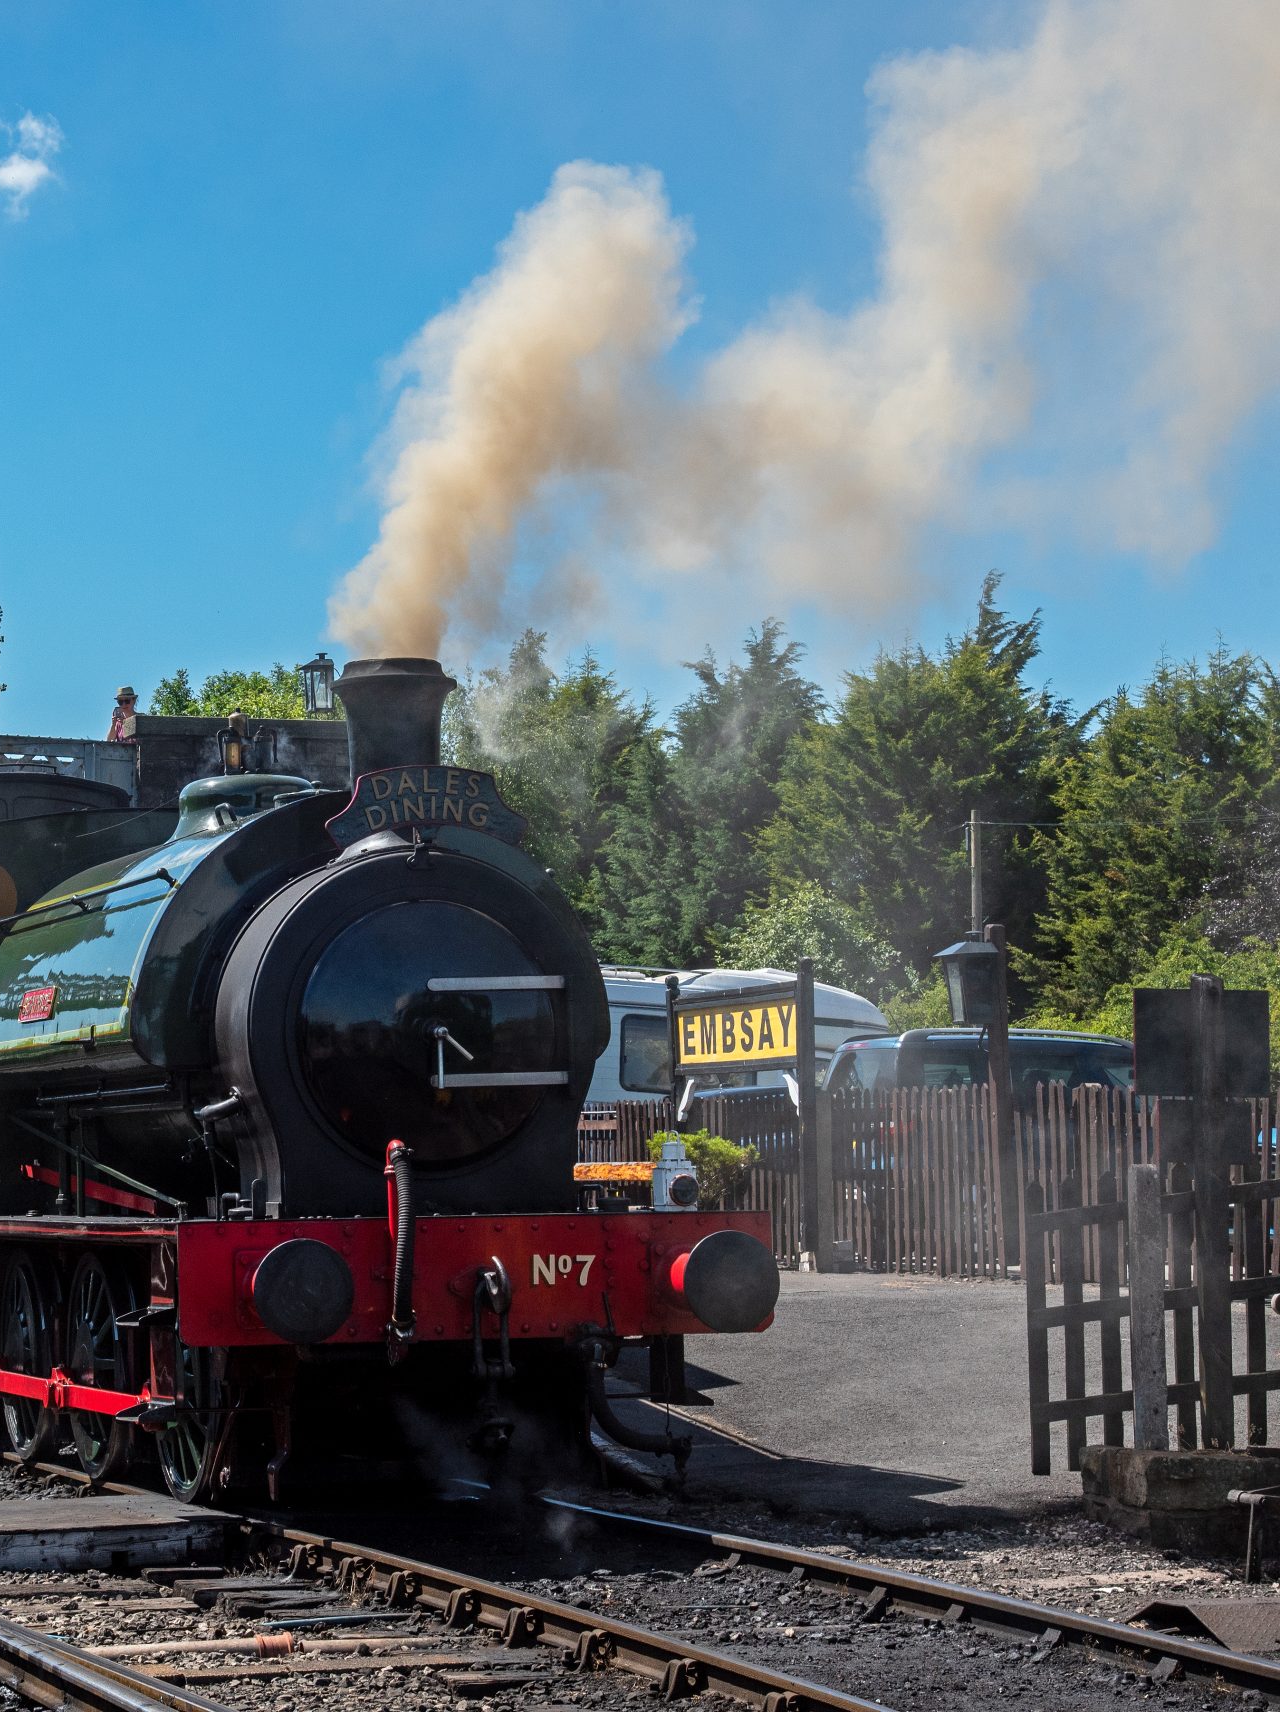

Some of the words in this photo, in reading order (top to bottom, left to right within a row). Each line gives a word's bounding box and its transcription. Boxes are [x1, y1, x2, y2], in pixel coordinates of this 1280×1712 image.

[371, 769, 481, 800] DALES
[364, 796, 490, 830] DINING
[683, 1002, 796, 1056] EMBSAY
